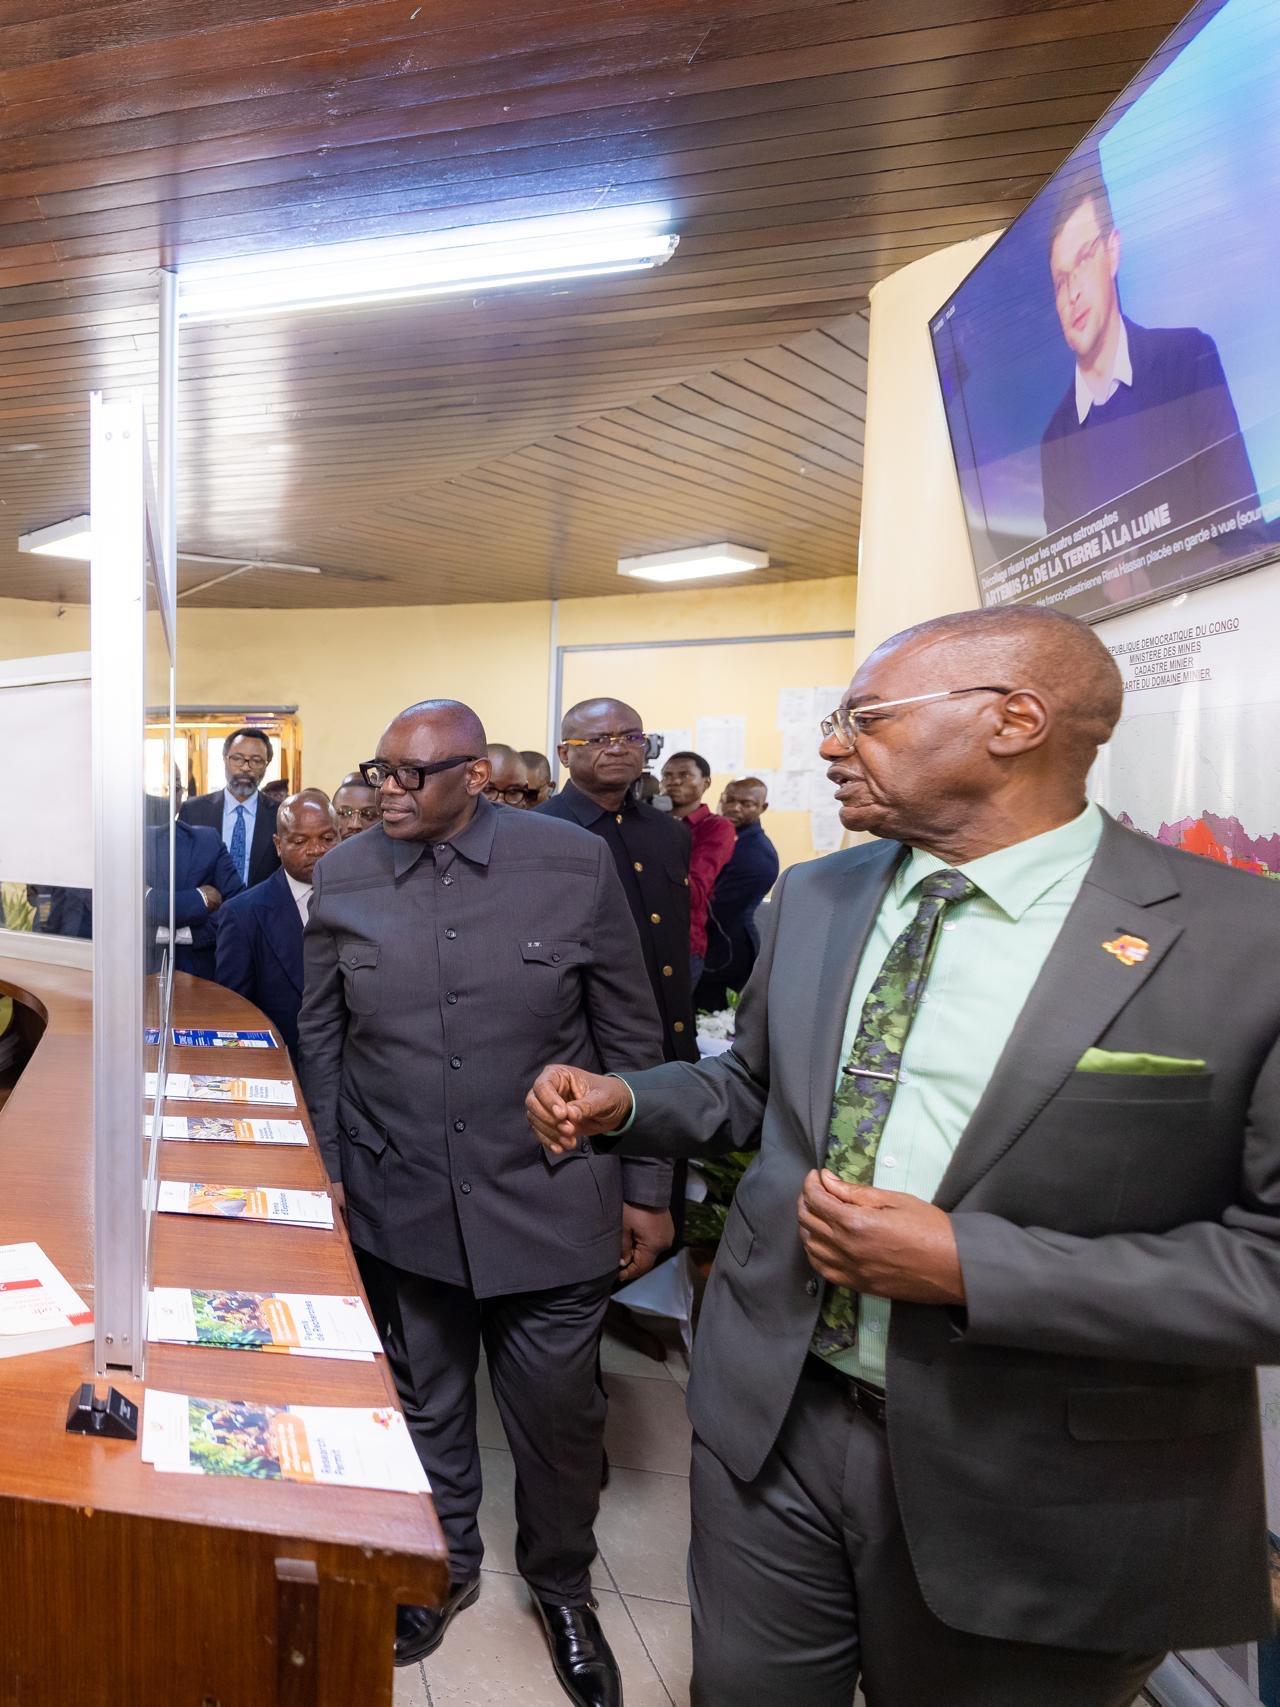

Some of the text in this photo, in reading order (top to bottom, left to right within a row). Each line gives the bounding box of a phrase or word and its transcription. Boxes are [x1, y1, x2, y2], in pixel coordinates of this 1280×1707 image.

[1025, 553, 1040, 570] pour
[1039, 546, 1050, 560] les
[1050, 536, 1072, 556] quatre
[1072, 511, 1119, 542] astronautes
[1033, 563, 1049, 586] DE
[1047, 556, 1064, 579] LA
[1063, 537, 1102, 570] TERRE
[1101, 530, 1111, 554] À
[1111, 521, 1132, 548] LA
[1131, 502, 1171, 539] LUNE
[1101, 563, 1121, 583] Rima
[1118, 555, 1146, 576] Hassan
[1146, 544, 1173, 567] placée
[1172, 541, 1184, 554] en
[1184, 528, 1210, 552] garde
[1210, 523, 1218, 538] à
[1217, 518, 1237, 534] vue
[1141, 627, 1194, 649] DEMOCRATIQUE
[1195, 624, 1207, 637] DU
[1208, 617, 1240, 634] CONGO
[1129, 640, 1202, 664] MINISTERE DES MINES
[1134, 656, 1194, 676] CADASTRE MINIER
[1141, 677, 1151, 689] DU
[1151, 672, 1181, 687] DOMAINE
[1182, 667, 1211, 682] MINIER
